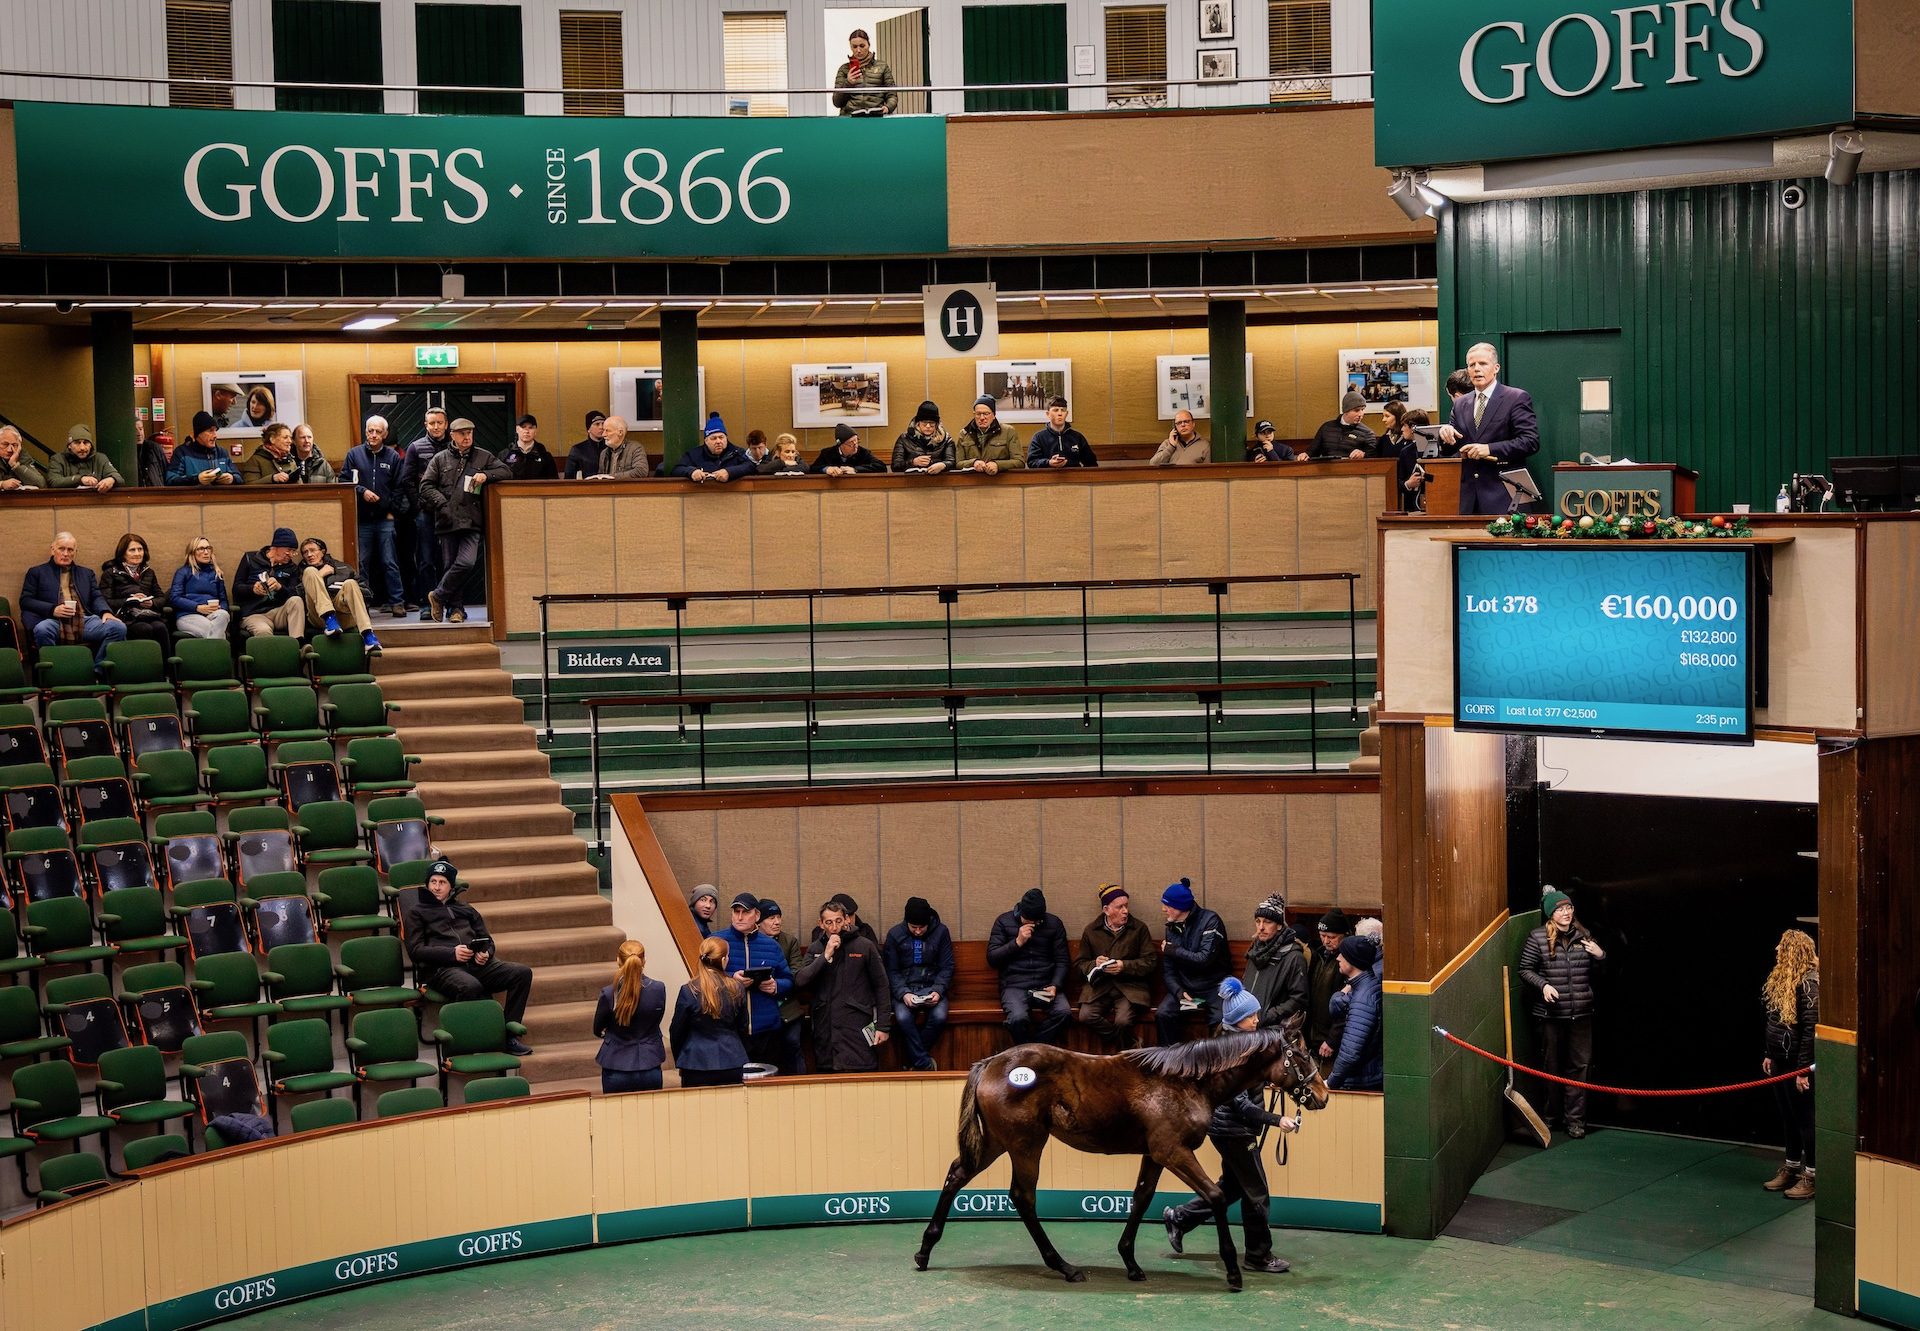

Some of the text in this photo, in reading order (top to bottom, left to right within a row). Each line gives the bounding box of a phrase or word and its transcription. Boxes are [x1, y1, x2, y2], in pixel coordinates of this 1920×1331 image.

[1459, 0, 1764, 104] GOFFS
[183, 142, 792, 225] GOFFS SINCE 1866
[946, 306, 978, 338] H
[1409, 356, 1431, 367] 2023
[1560, 488, 1662, 518] GOFFS
[1465, 594, 1539, 614] Lot 378
[1599, 594, 1738, 625] €160,000
[1680, 629, 1738, 645] £132,800
[567, 652, 663, 667] Bidders Area
[1679, 651, 1738, 668] $168,000
[1464, 703, 1496, 715] GOFFS
[1506, 705, 1598, 719] Last Lot 377 €2,500
[148, 722, 157, 732] 10
[1695, 713, 1739, 728] 2:35 pm
[81, 730, 89, 740] 9
[11, 737, 19, 748] 8
[27, 796, 35, 806] 7
[100, 790, 108, 800] 8
[261, 841, 268, 852] 9
[116, 851, 125, 861] 7
[43, 859, 51, 869] 6
[206, 915, 216, 928] 7
[163, 1002, 170, 1013] 5
[85, 1010, 95, 1022] 4
[222, 1076, 231, 1088] 4
[1014, 1073, 1029, 1082] 378
[824, 1196, 890, 1216] GOFFS
[1081, 1195, 1134, 1213] GOFF
[458, 1230, 523, 1257] GOFFS
[335, 1251, 399, 1280] GOFFS
[214, 1277, 276, 1311] GOFFS
